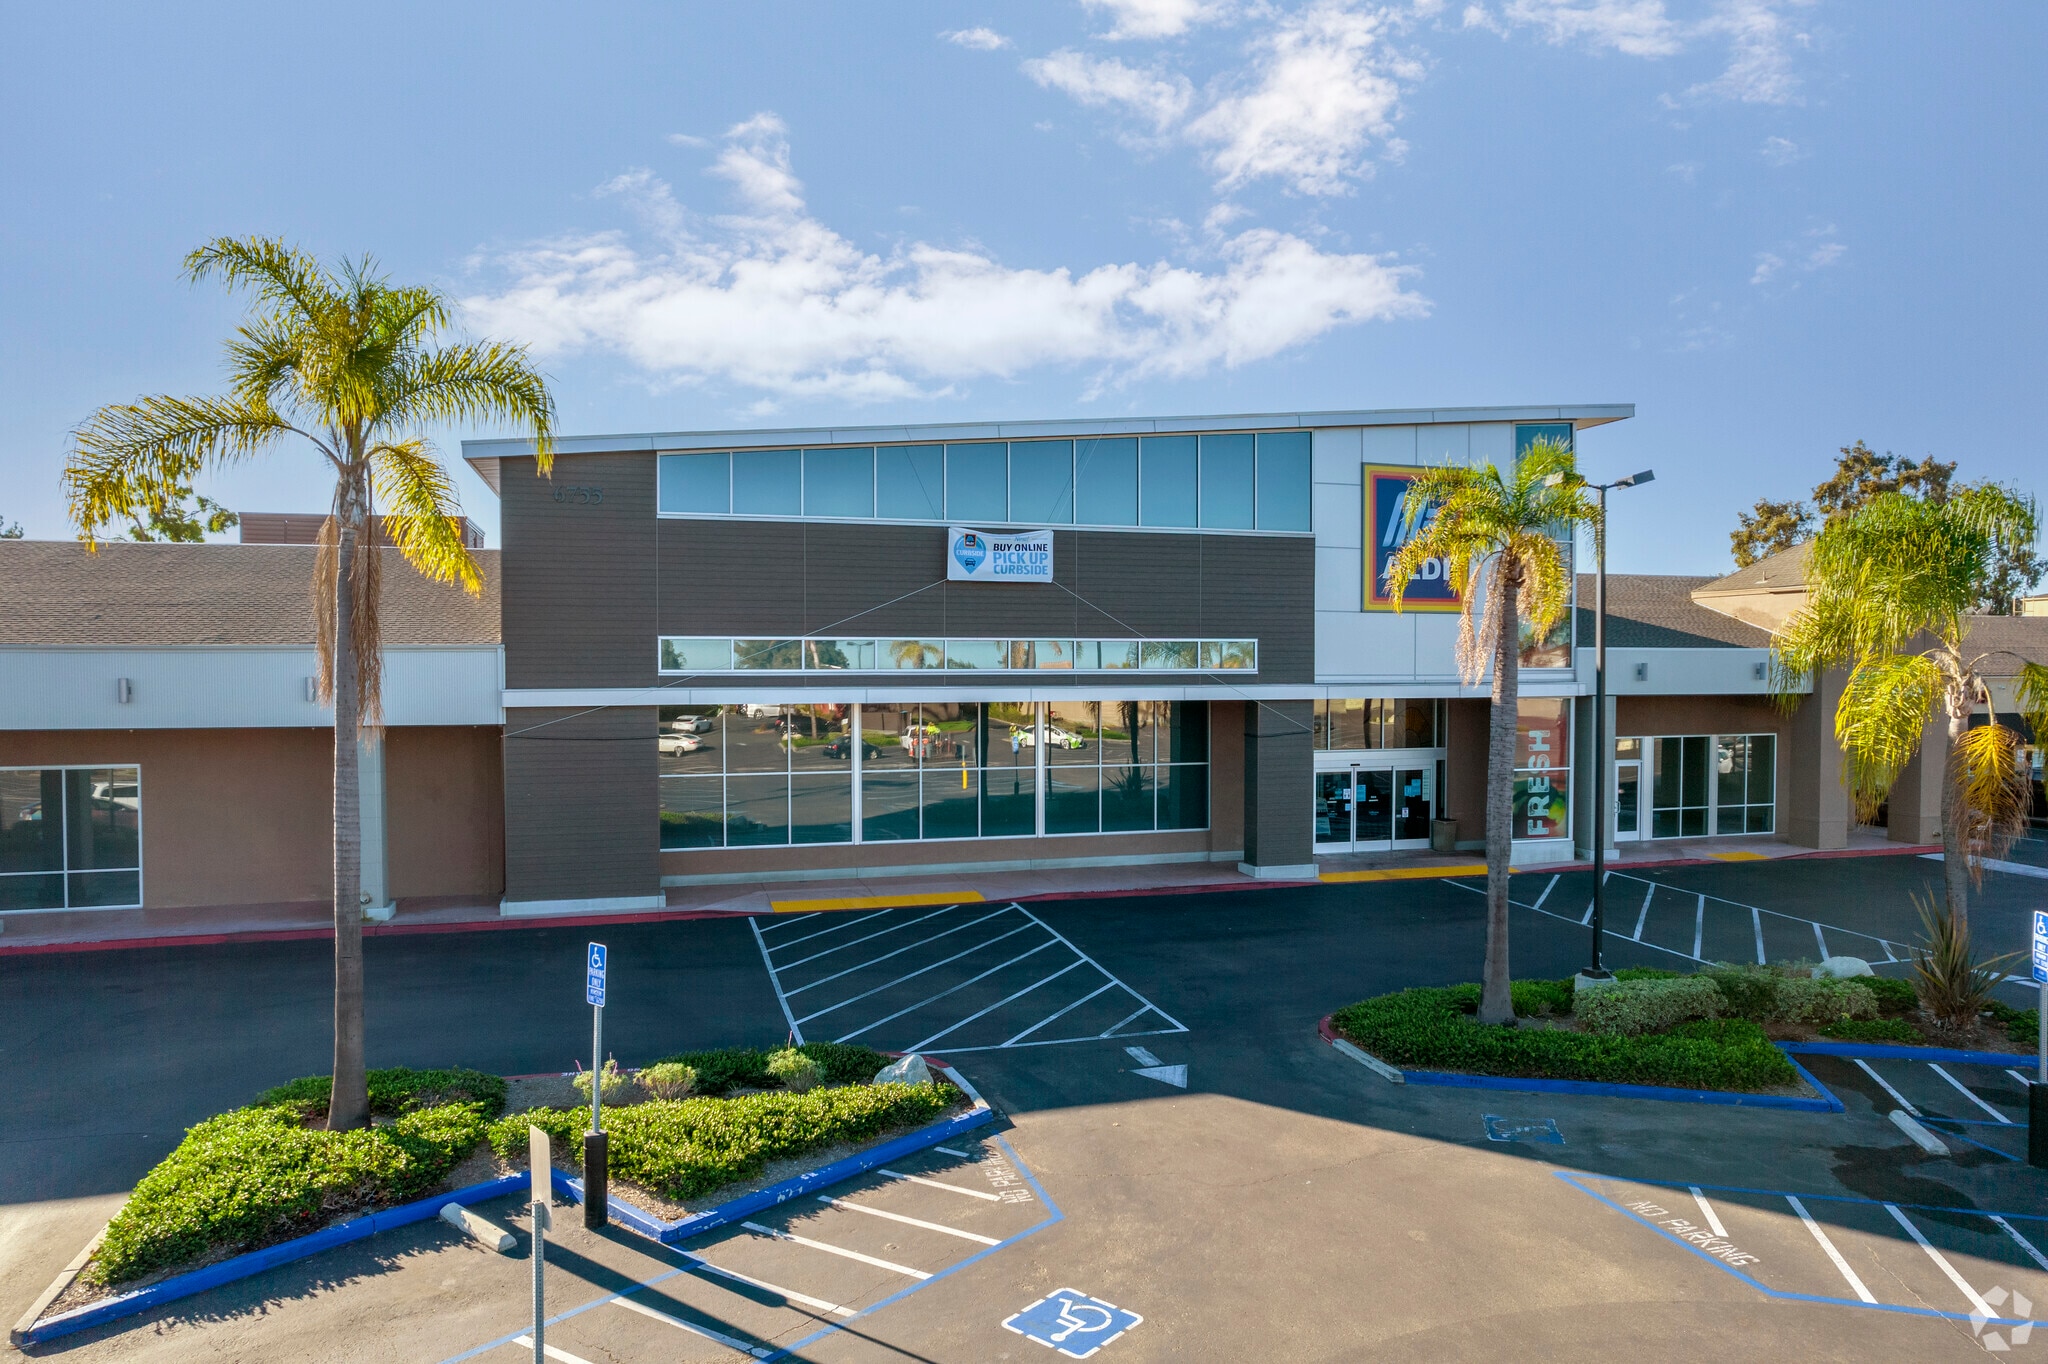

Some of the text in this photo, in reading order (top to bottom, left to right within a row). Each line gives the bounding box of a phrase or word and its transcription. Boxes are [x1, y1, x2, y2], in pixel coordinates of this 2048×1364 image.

[993, 543, 1048, 552] BUY ONLINE
[993, 552, 1049, 565] PICK UP
[993, 564, 1049, 575] CURBSIDE
[1527, 730, 1550, 835] FRESH
[998, 1189, 1034, 1204] NO
[1625, 1201, 1761, 1266] NO PARKING
